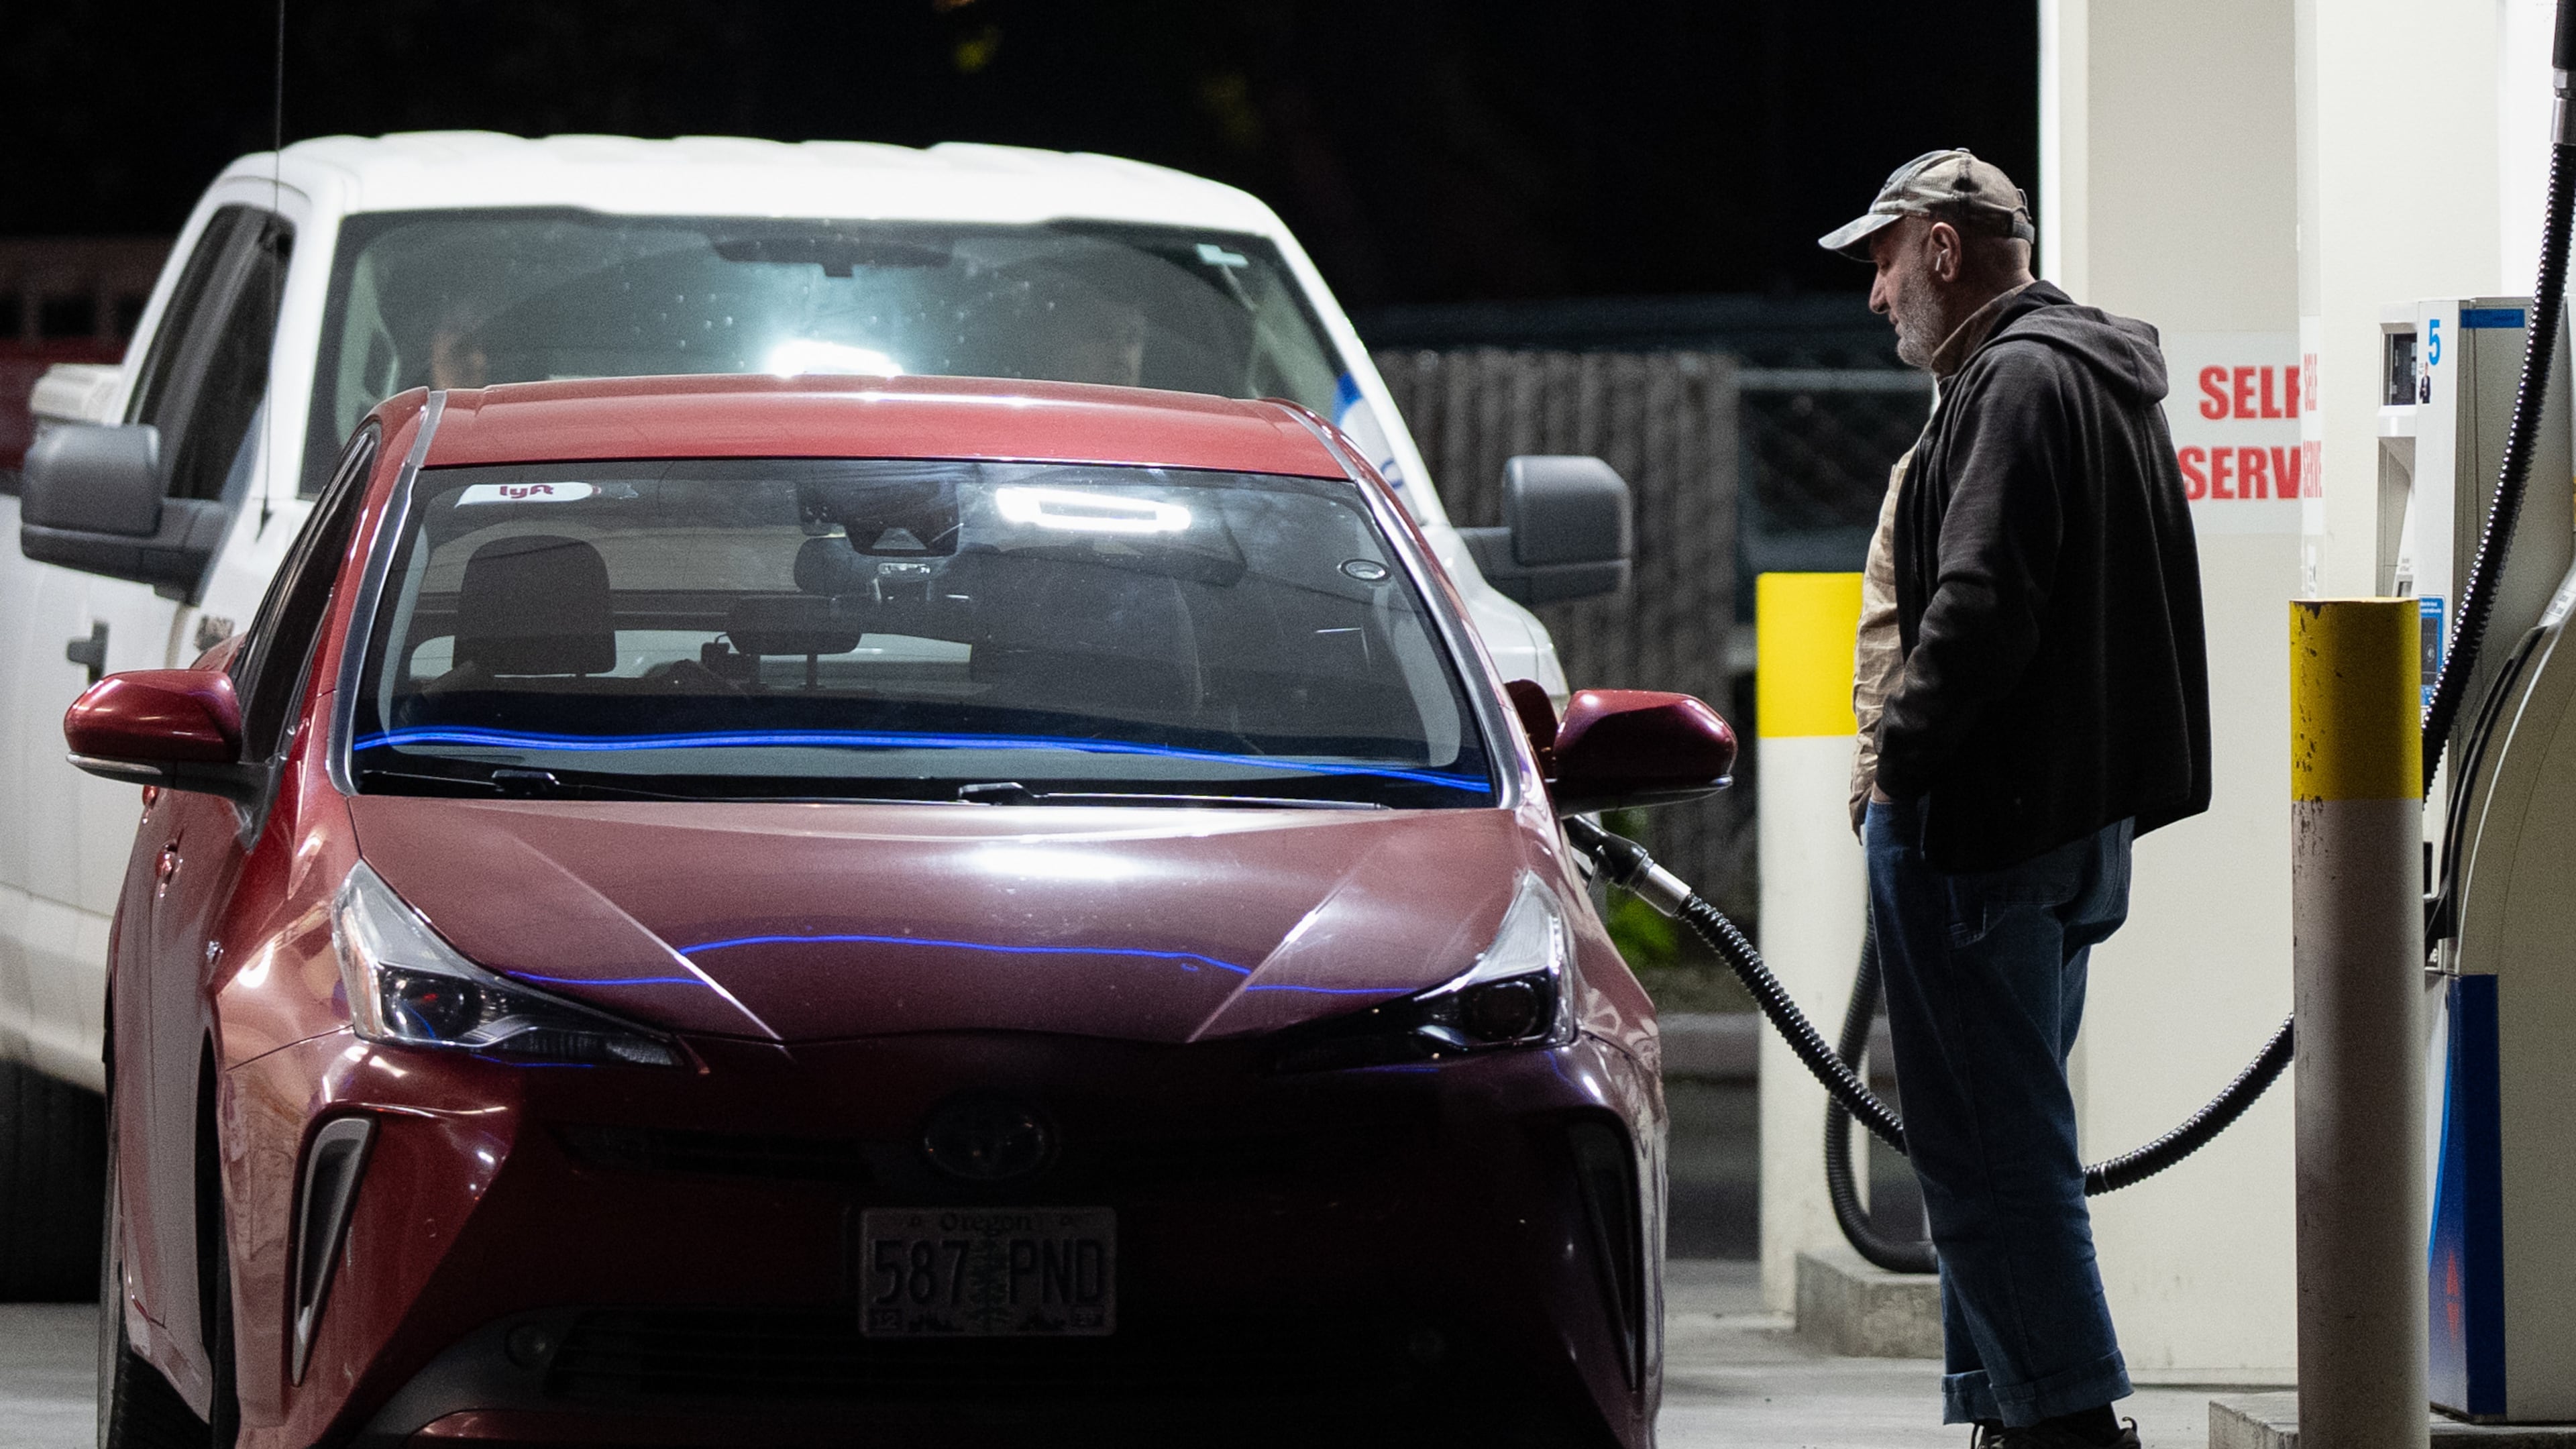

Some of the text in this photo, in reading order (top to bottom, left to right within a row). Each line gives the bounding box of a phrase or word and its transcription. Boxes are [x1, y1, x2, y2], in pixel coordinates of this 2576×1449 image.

[2428, 319, 2441, 366] 5
[2198, 364, 2300, 420] SELF
[498, 484, 554, 499] lyft
[2178, 445, 2301, 500] SERV
[939, 1212, 1032, 1236] Oregon
[872, 1239, 1105, 1305] 587 PND
